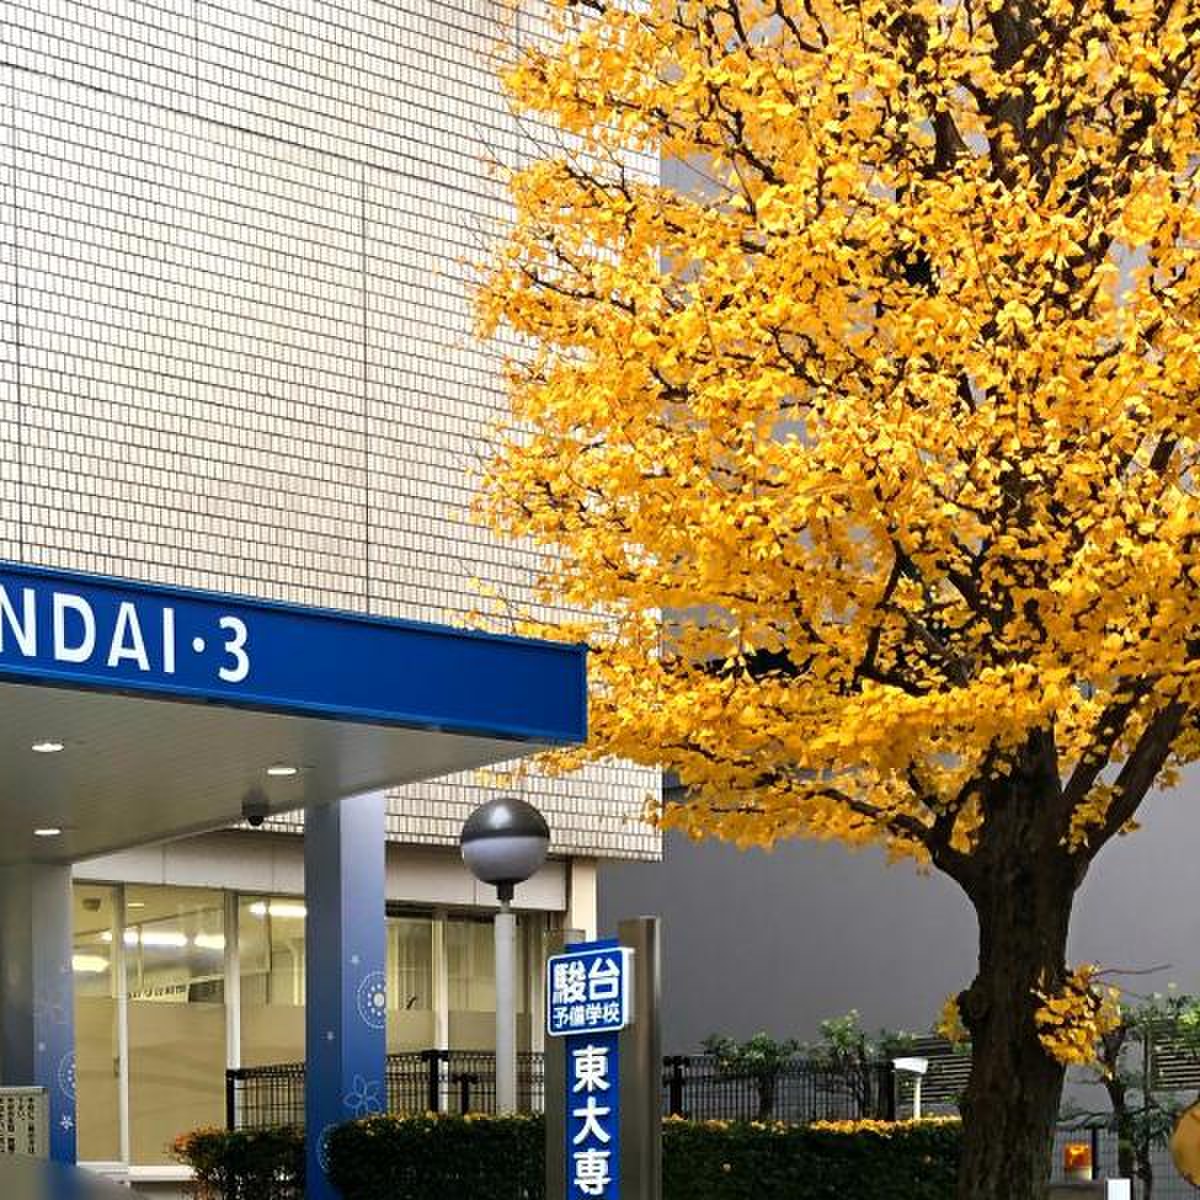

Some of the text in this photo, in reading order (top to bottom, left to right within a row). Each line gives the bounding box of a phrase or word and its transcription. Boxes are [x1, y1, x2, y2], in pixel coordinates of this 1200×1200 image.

[553, 957, 620, 1004] 駿台
[553, 1002, 620, 1028] 予備学校
